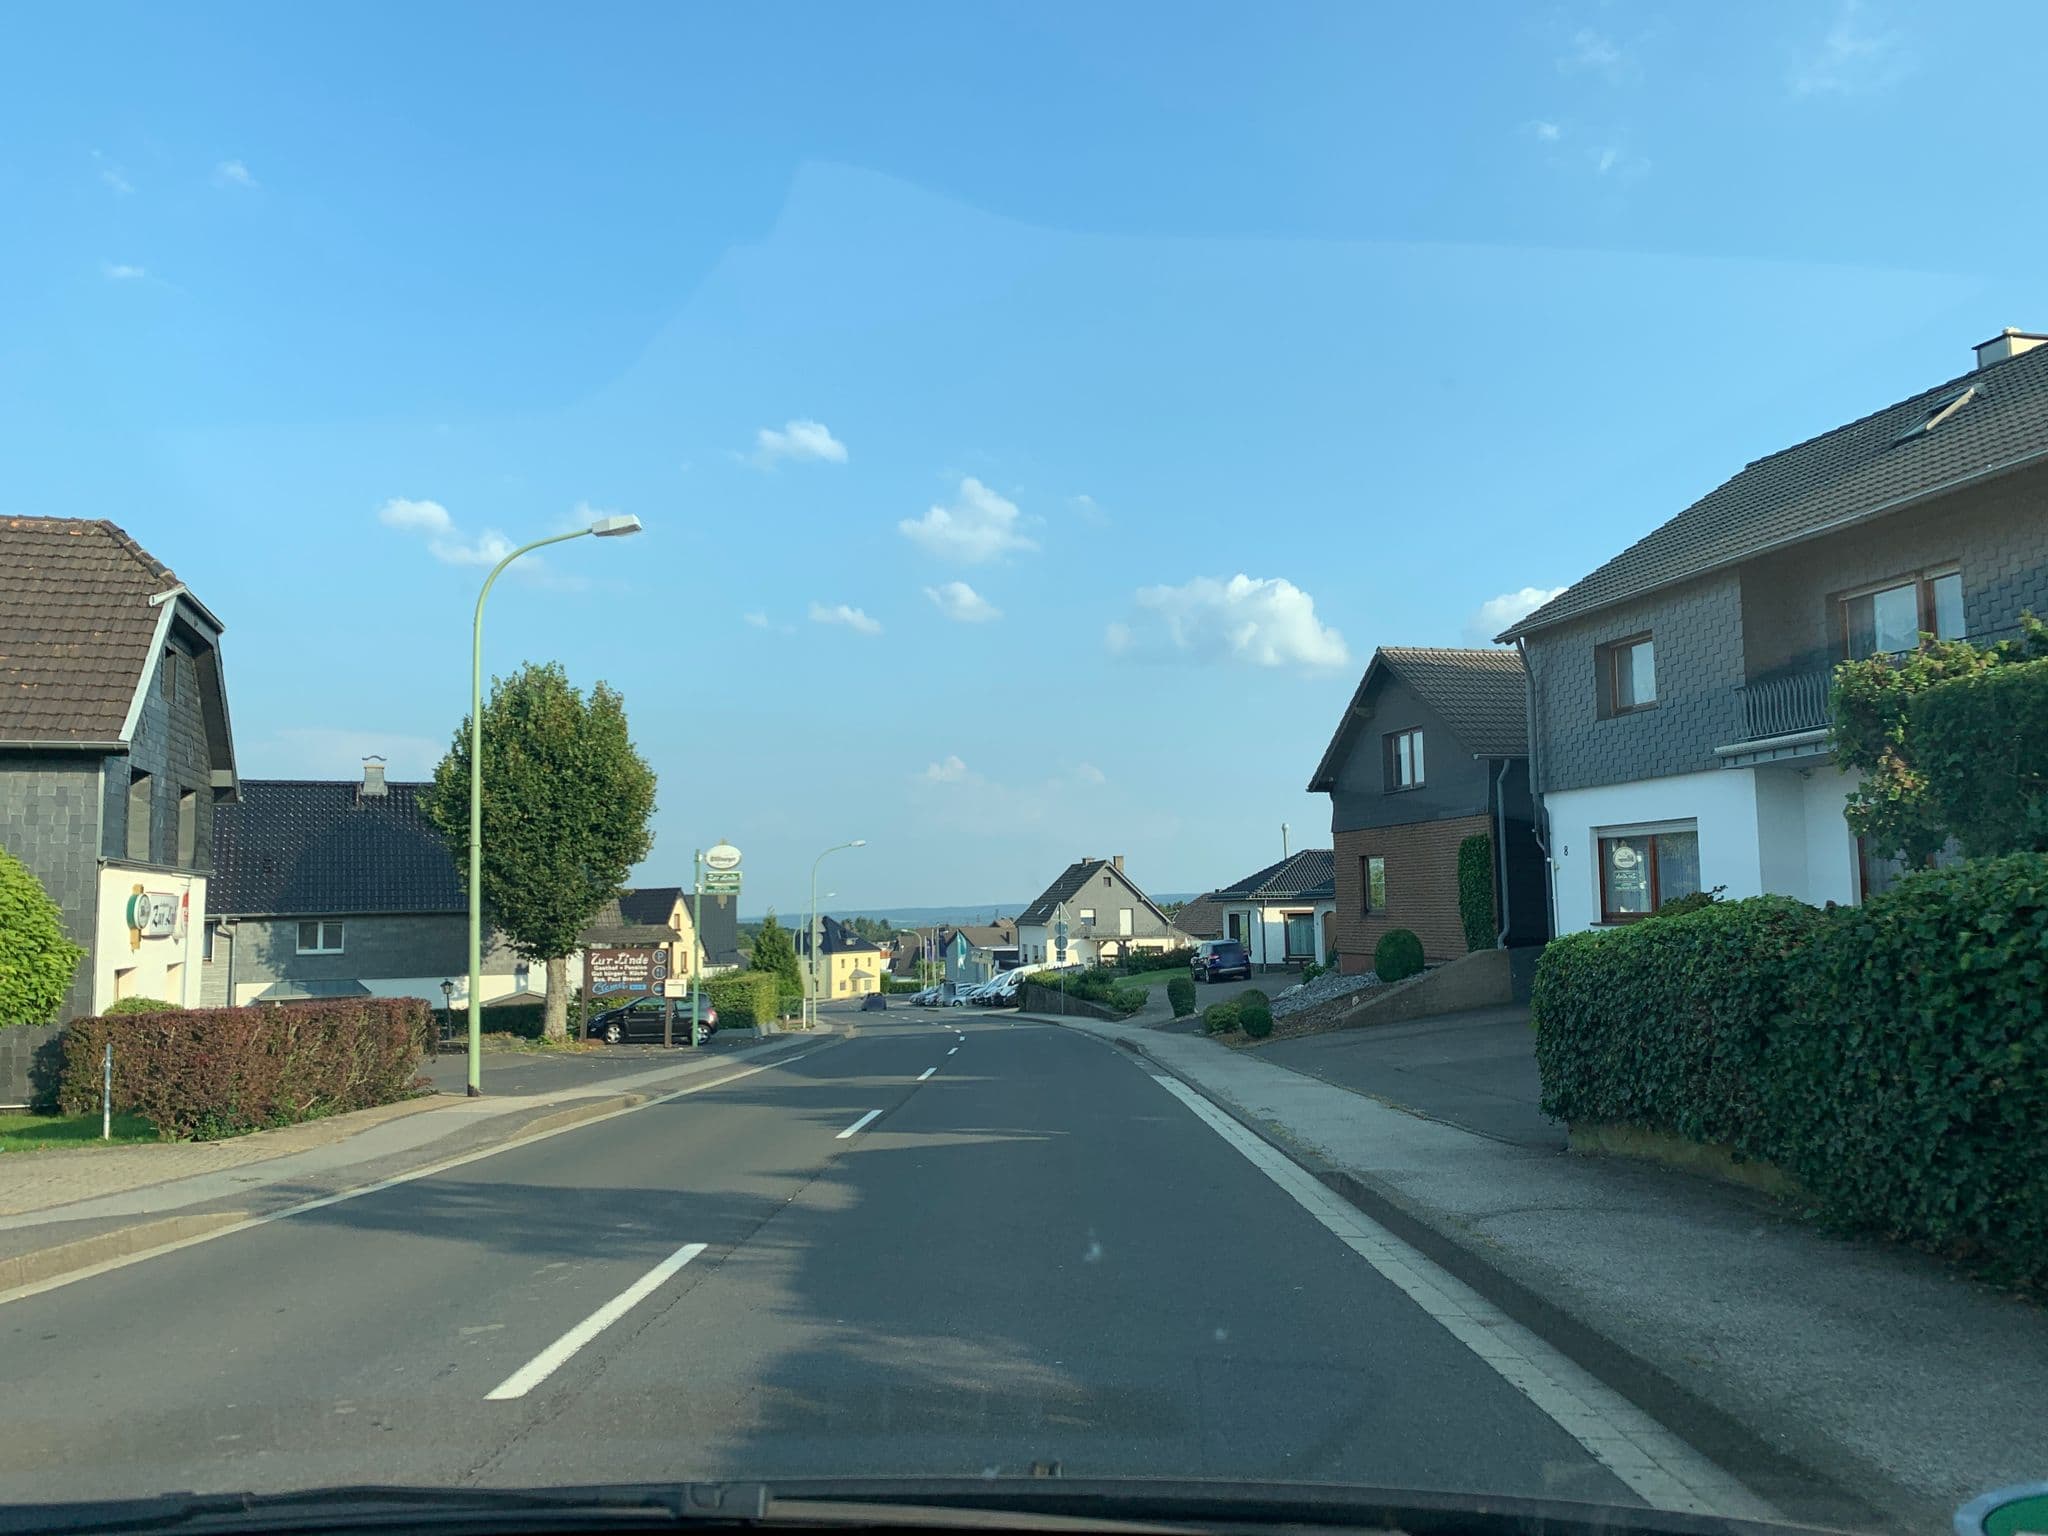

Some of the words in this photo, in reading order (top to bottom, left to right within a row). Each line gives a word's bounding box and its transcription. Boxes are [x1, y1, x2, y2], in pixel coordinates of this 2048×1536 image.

[1563, 845, 1569, 856] 8
[591, 953, 613, 965] Zur
[614, 952, 649, 965] Linde
